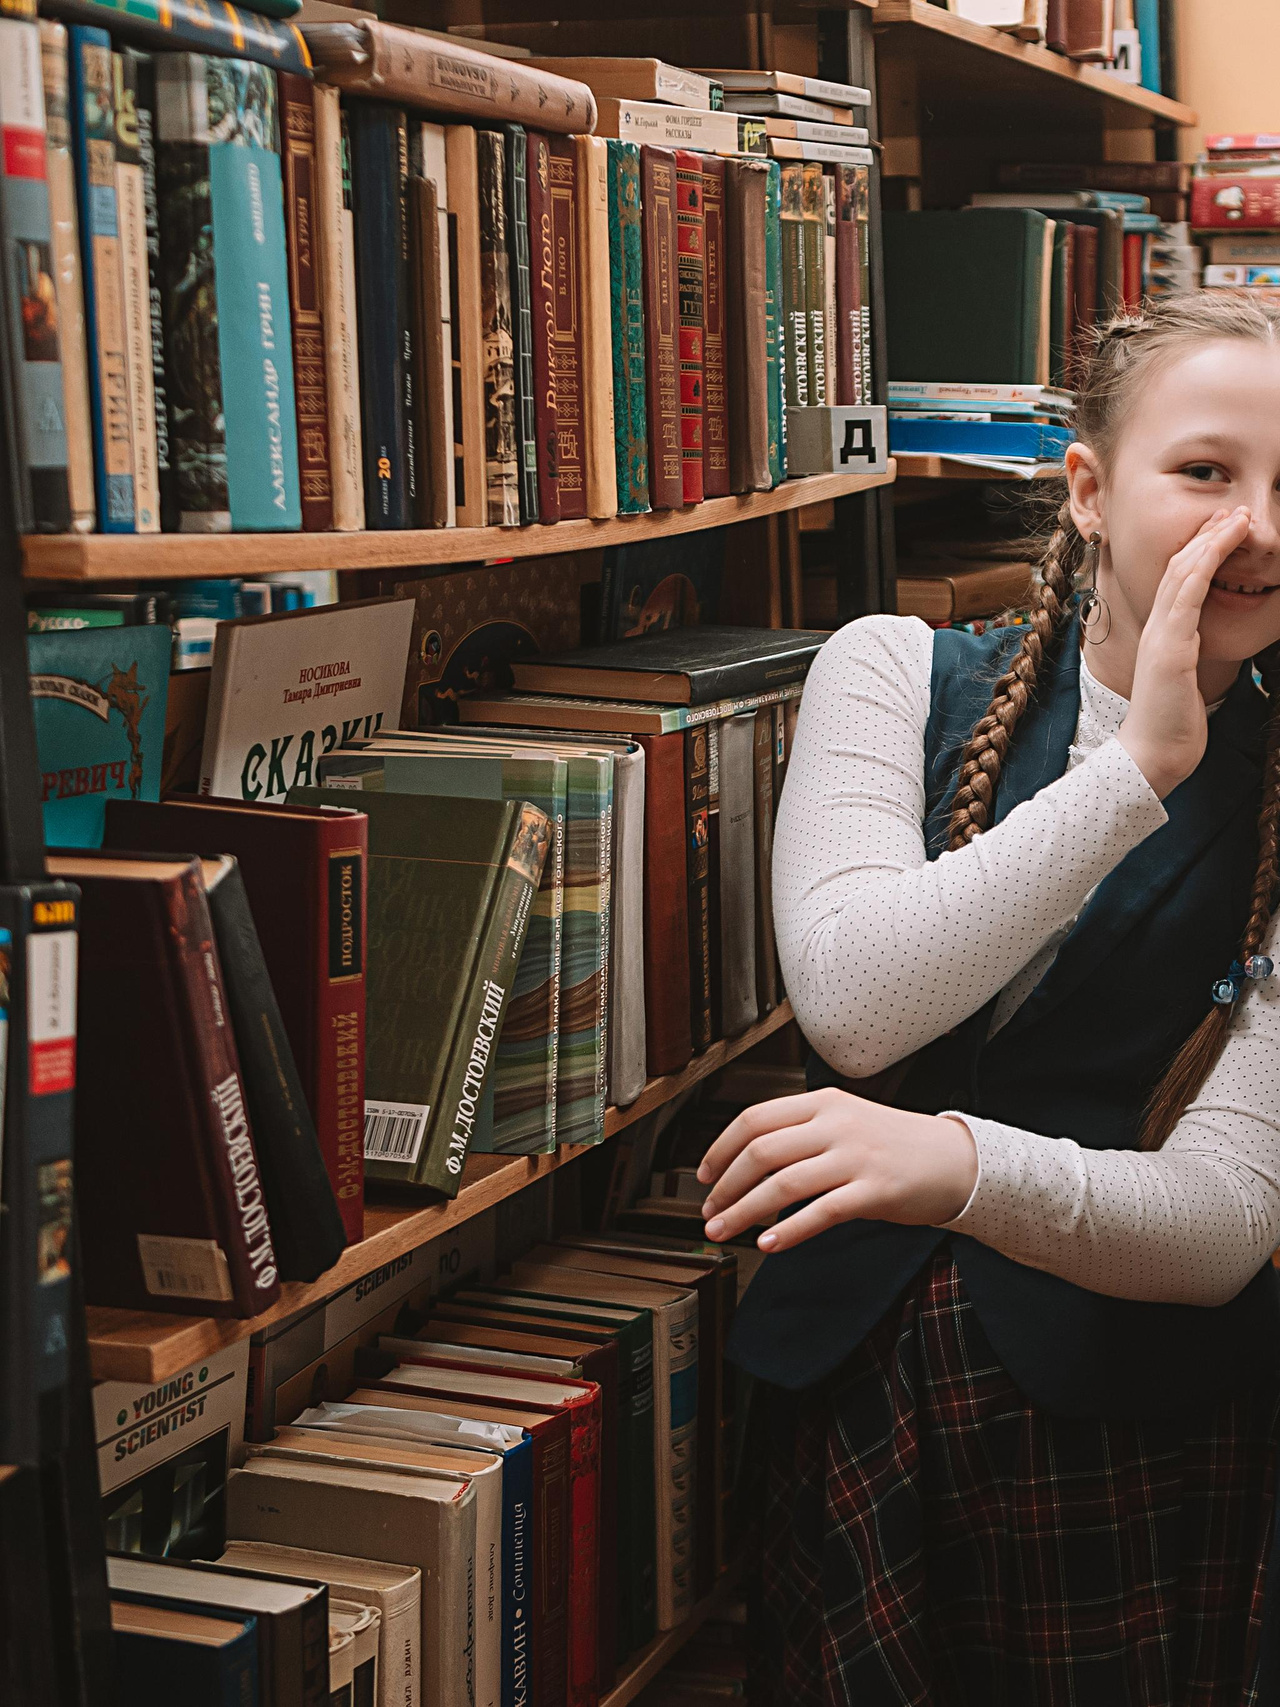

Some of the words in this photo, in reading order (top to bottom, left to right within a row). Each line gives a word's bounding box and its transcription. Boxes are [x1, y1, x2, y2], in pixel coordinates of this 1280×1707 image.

[665, 127, 693, 140] РАССКАЗЫ
[557, 236, 566, 279] ГЮГО
[660, 235, 668, 276] ГЕТЕ
[708, 240, 716, 276] ГЕТЕ
[256, 280, 276, 351] ГРИН
[627, 288, 645, 383] ГЕТЕ
[262, 357, 287, 512] АЛЕКСАНДР
[840, 419, 876, 464] Д
[378, 457, 392, 479] 20
[282, 687, 312, 704] Тамара
[312, 677, 362, 700] Дмитриевна
[299, 660, 351, 684] НОСИКОВА
[41, 759, 128, 801] РЕВИЧ
[555, 813, 564, 914] ДОСТОЕВСКОГО
[341, 865, 354, 966] ПОДРОСТОК
[554, 914, 562, 941] Ф.М.
[552, 944, 561, 1023] НАКАЗАНИЕ»
[354, 1250, 414, 1303] SCIENTIST
[132, 1370, 194, 1420] YOUNG
[114, 1394, 207, 1462] SCIENTIST
[487, 1542, 496, 1592] Альфонс
[512, 1501, 527, 1601] Сочинения
[404, 1639, 412, 1677] ДУДИН
[513, 1620, 528, 1707] АВИН
[404, 1684, 412, 1707] ИЛ
